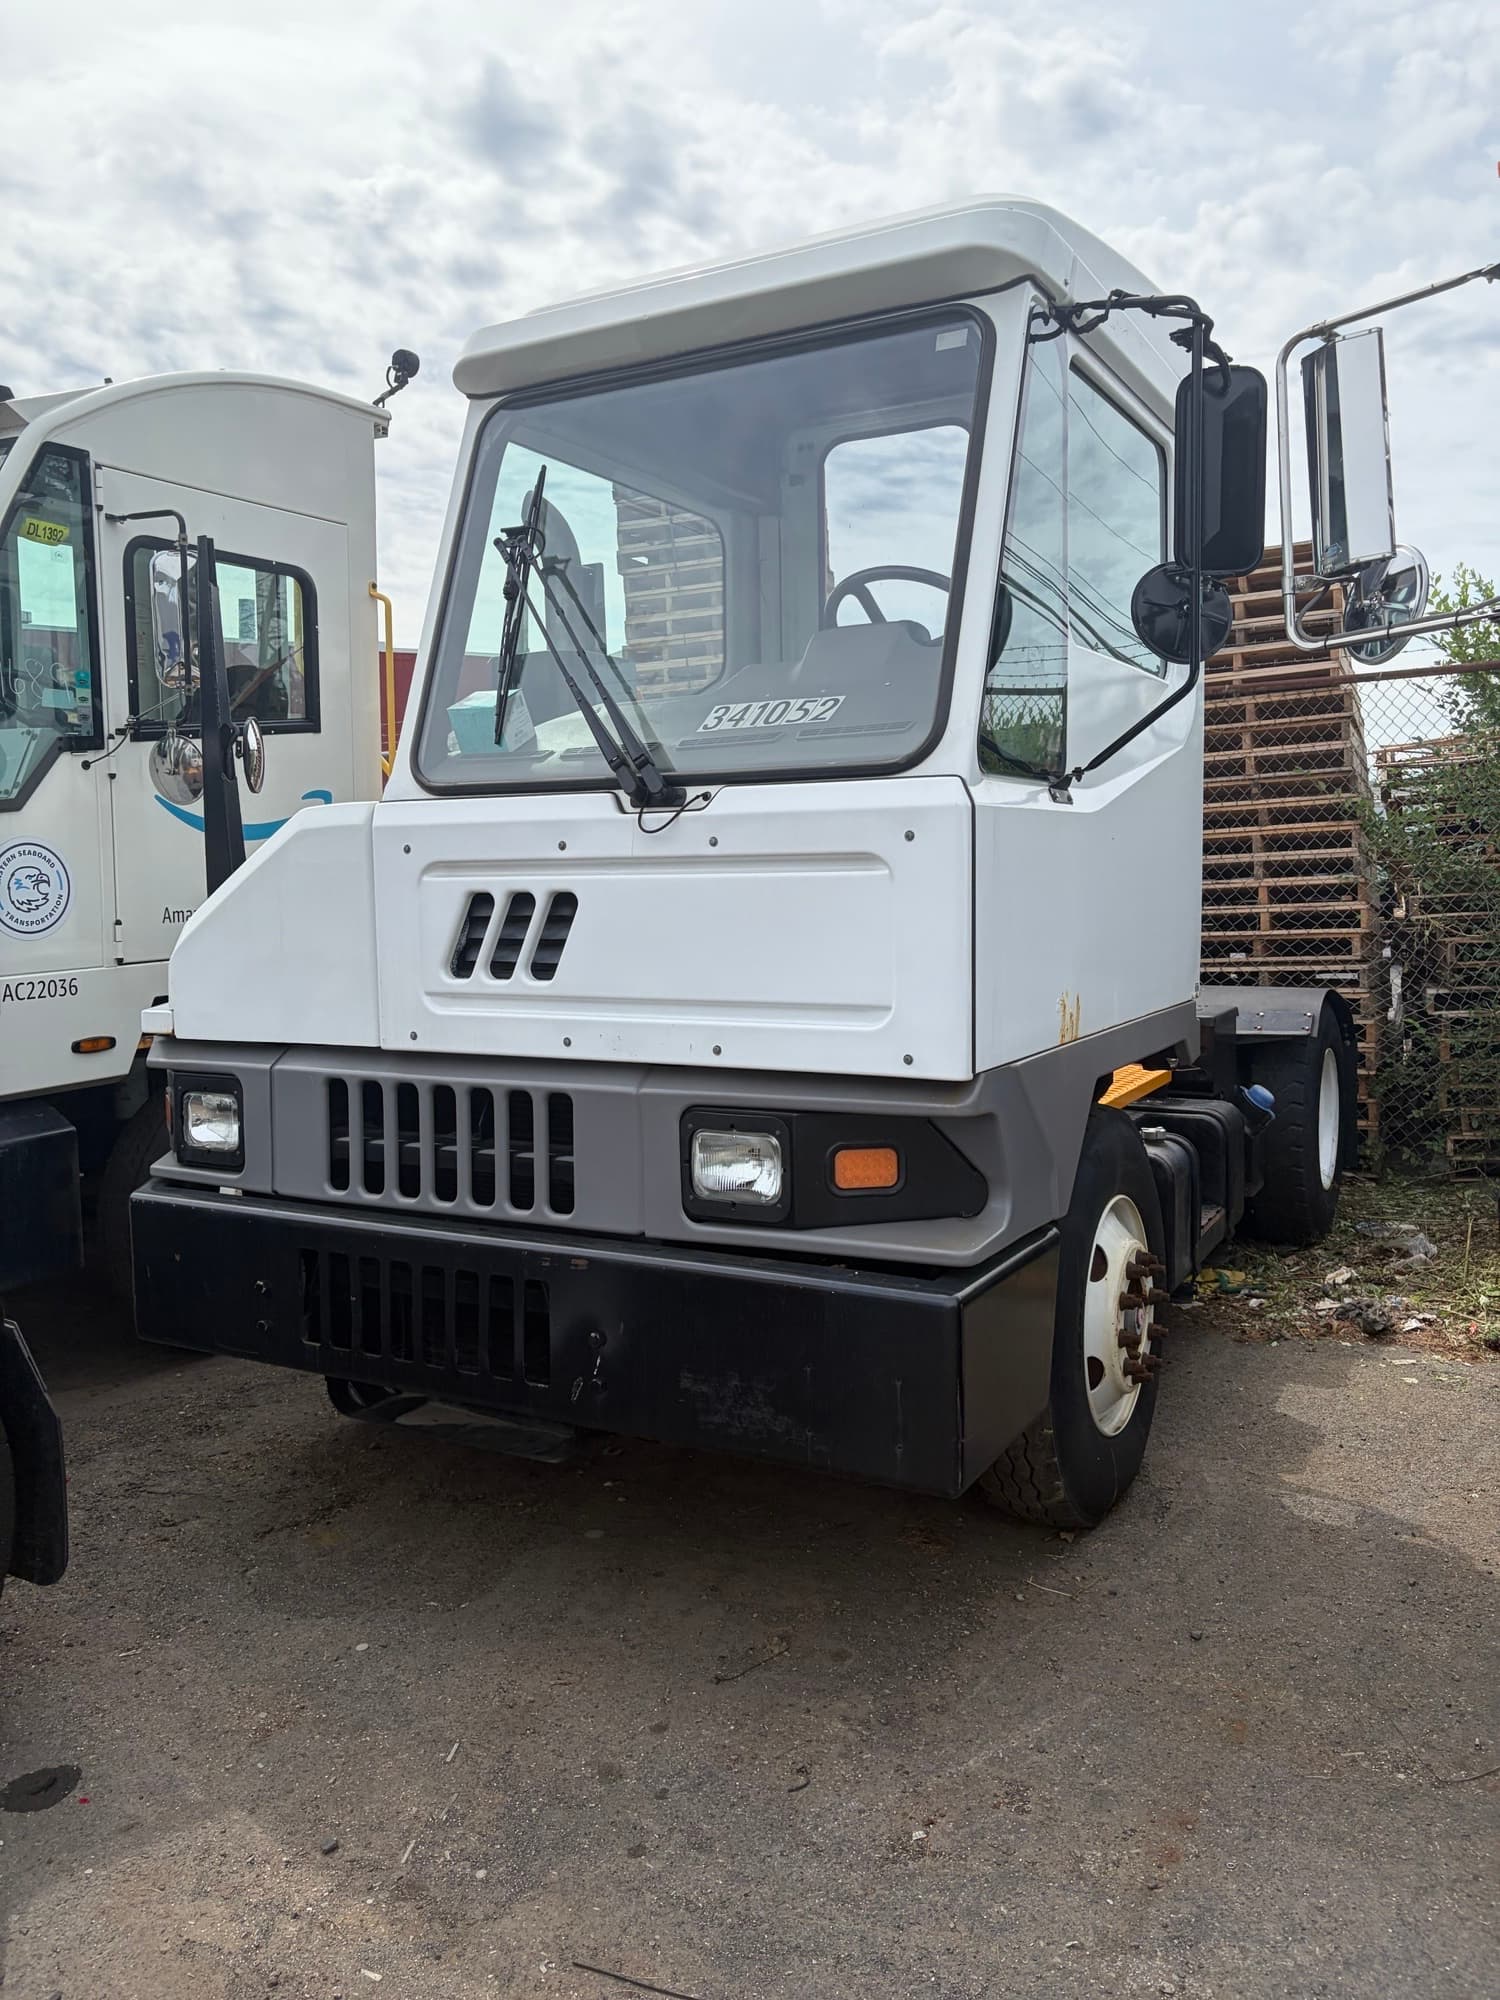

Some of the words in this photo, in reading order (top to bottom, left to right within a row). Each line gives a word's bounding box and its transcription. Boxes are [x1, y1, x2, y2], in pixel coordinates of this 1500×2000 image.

[27, 522, 64, 542] DL1392
[702, 698, 840, 730] 341052
[0, 853, 17, 880] STERN
[17, 850, 56, 869] SEABOARD
[5, 893, 63, 927] TRANSPORTATION
[162, 906, 197, 923] Ama
[2, 978, 79, 1002] AC22036
